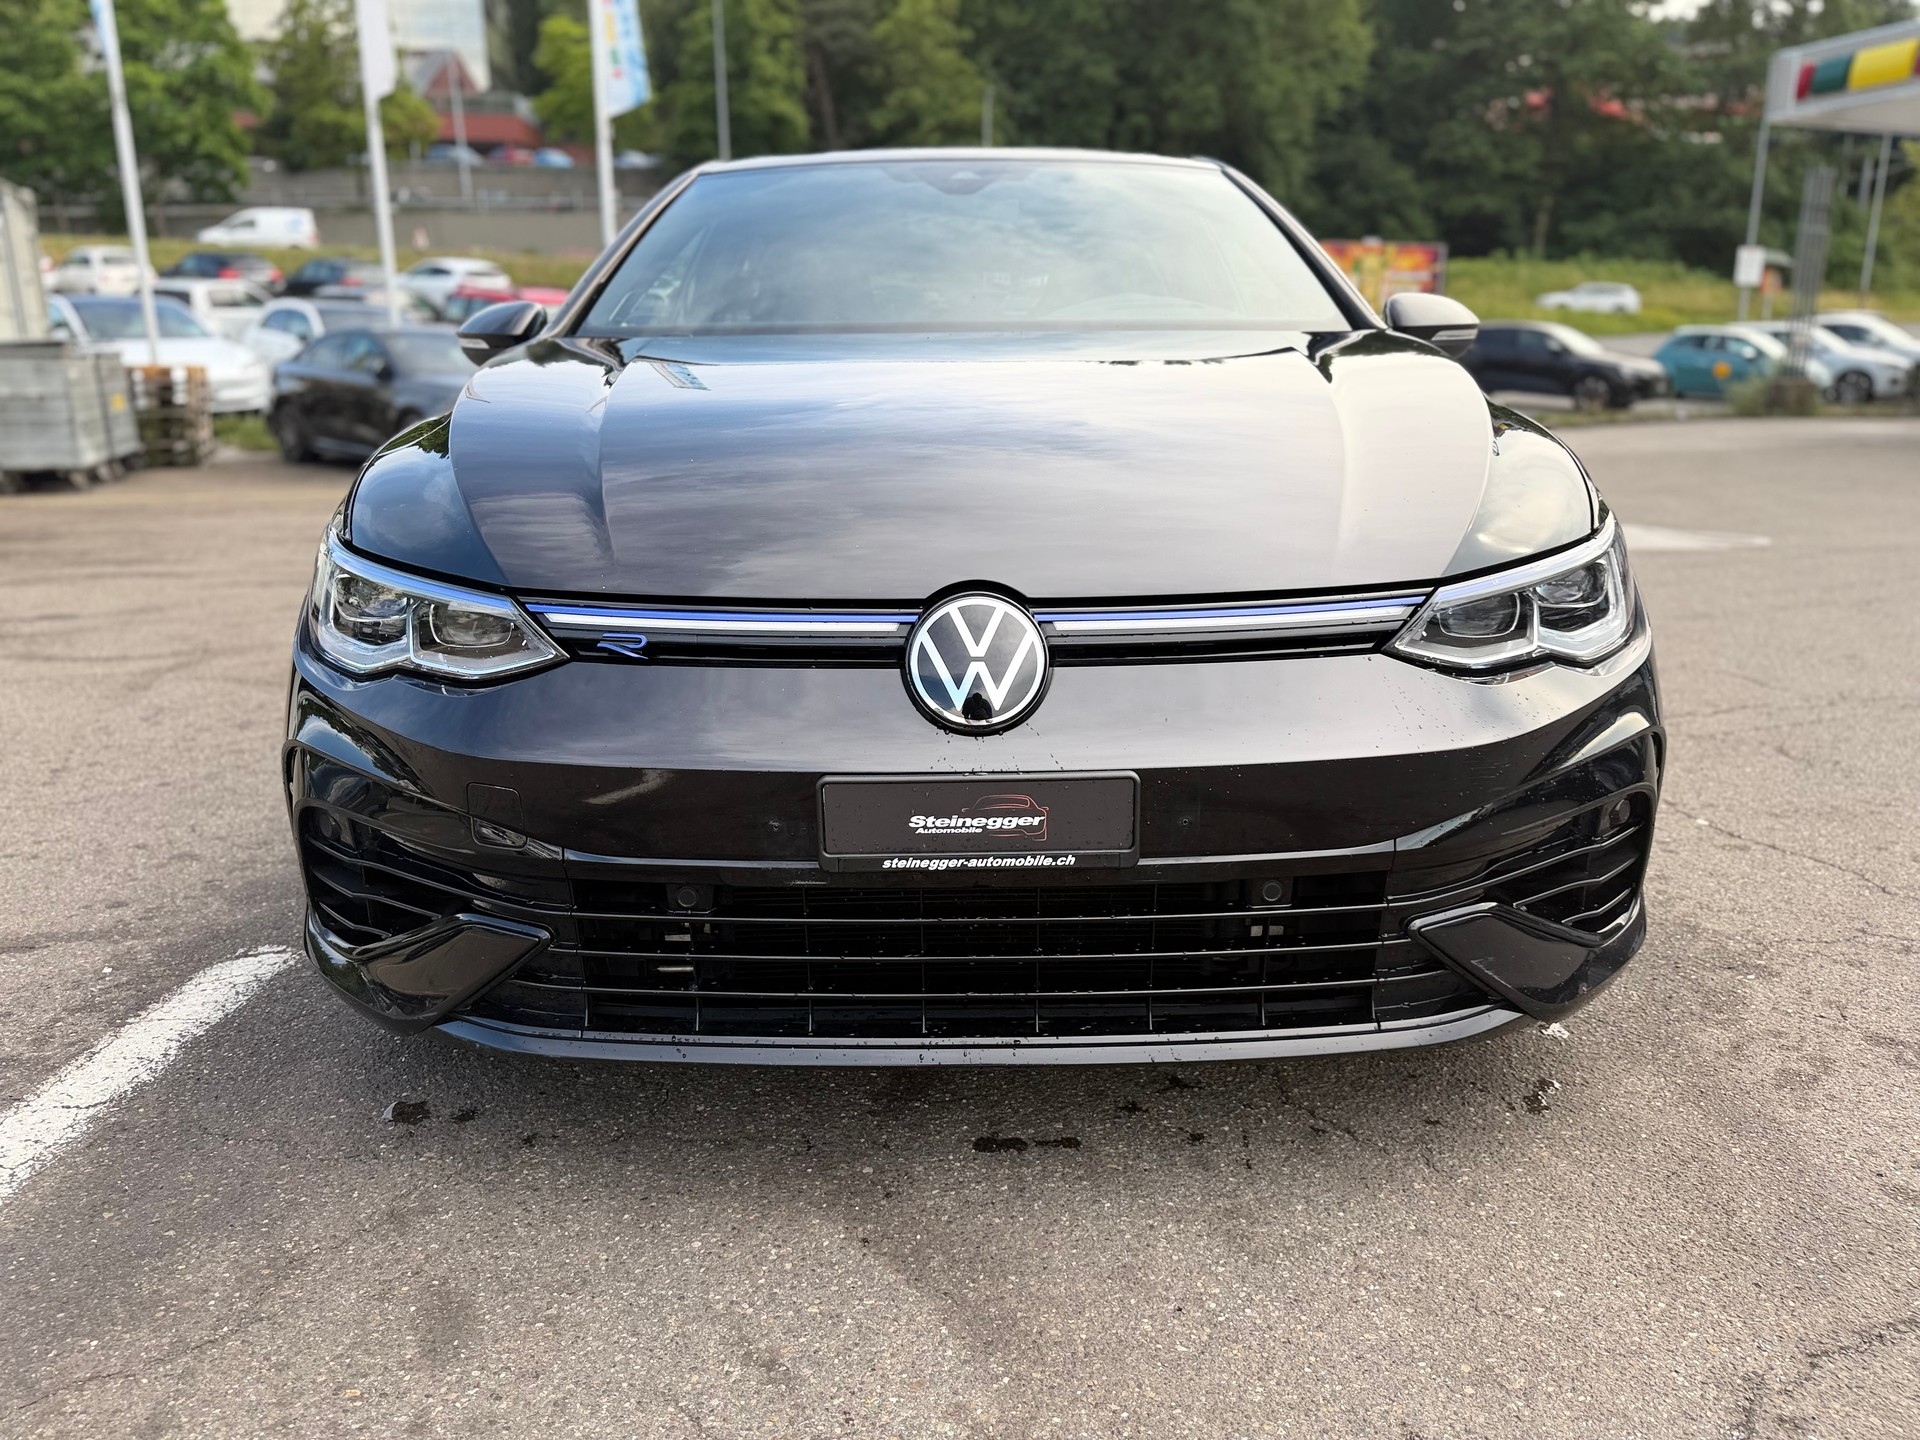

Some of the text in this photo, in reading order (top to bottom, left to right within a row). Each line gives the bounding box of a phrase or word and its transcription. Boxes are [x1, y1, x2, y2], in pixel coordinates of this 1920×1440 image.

[597, 632, 649, 660] R
[908, 814, 1046, 830] Steinegger
[915, 826, 983, 834] Automobile
[881, 853, 1076, 870] steinegger-automobile.ch
